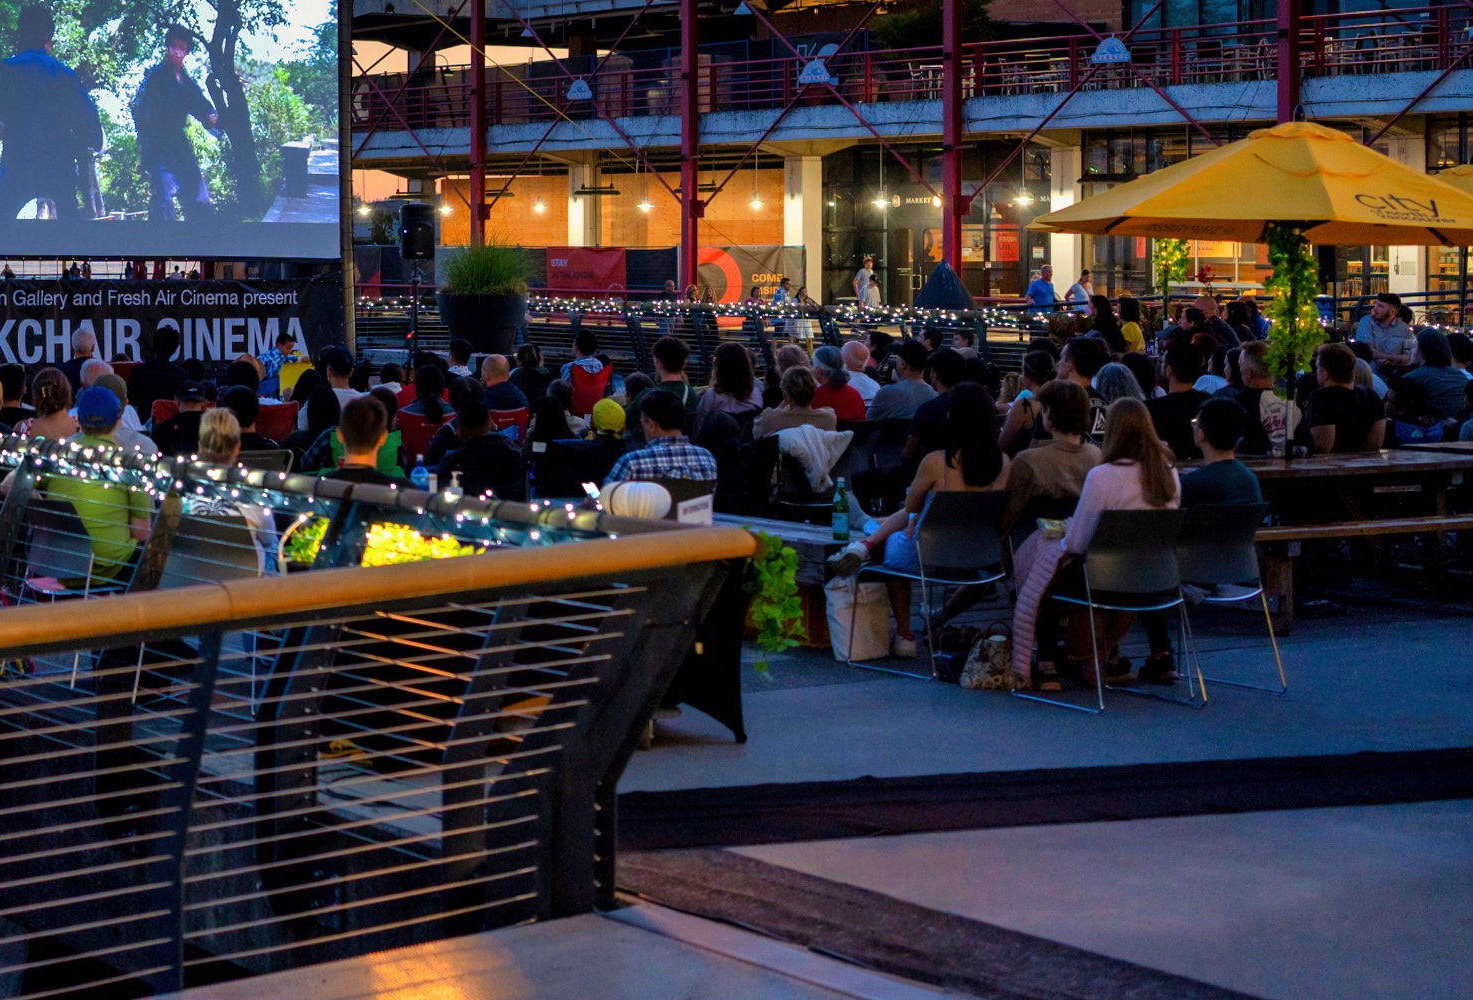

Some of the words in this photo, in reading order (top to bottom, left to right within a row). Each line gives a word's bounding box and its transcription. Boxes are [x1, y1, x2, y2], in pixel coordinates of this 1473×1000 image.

[550, 258, 568, 267] STAY
[751, 273, 783, 283] COME
[12, 289, 68, 310] Gallery
[73, 289, 102, 306] and
[108, 289, 151, 306] Fresh
[156, 289, 177, 306] Air
[180, 288, 239, 306] Cinema
[243, 289, 298, 309] present
